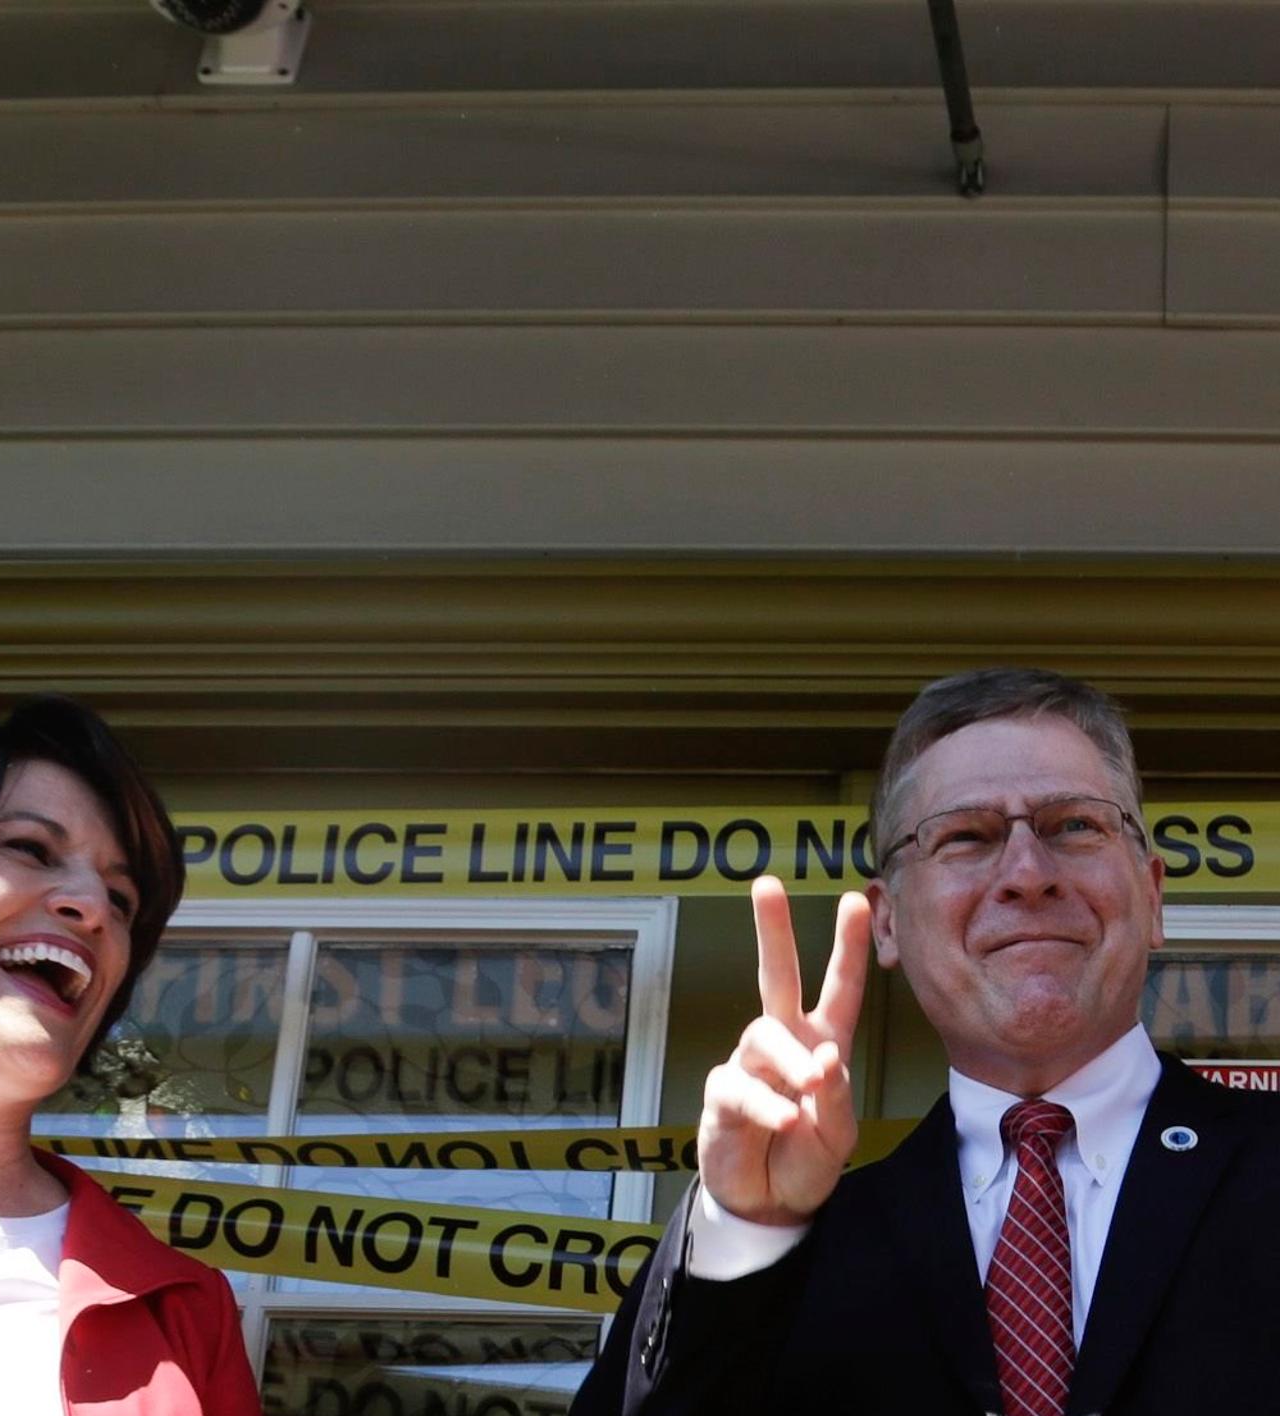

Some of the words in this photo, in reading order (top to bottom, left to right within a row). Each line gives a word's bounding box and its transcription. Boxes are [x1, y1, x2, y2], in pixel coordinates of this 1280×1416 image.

[177, 823, 448, 886] POLICE
[468, 820, 637, 883] LINE
[658, 819, 772, 882] DO
[169, 1191, 285, 1259] DO
[304, 1204, 480, 1279] NOT
[488, 1223, 661, 1298] CRO
